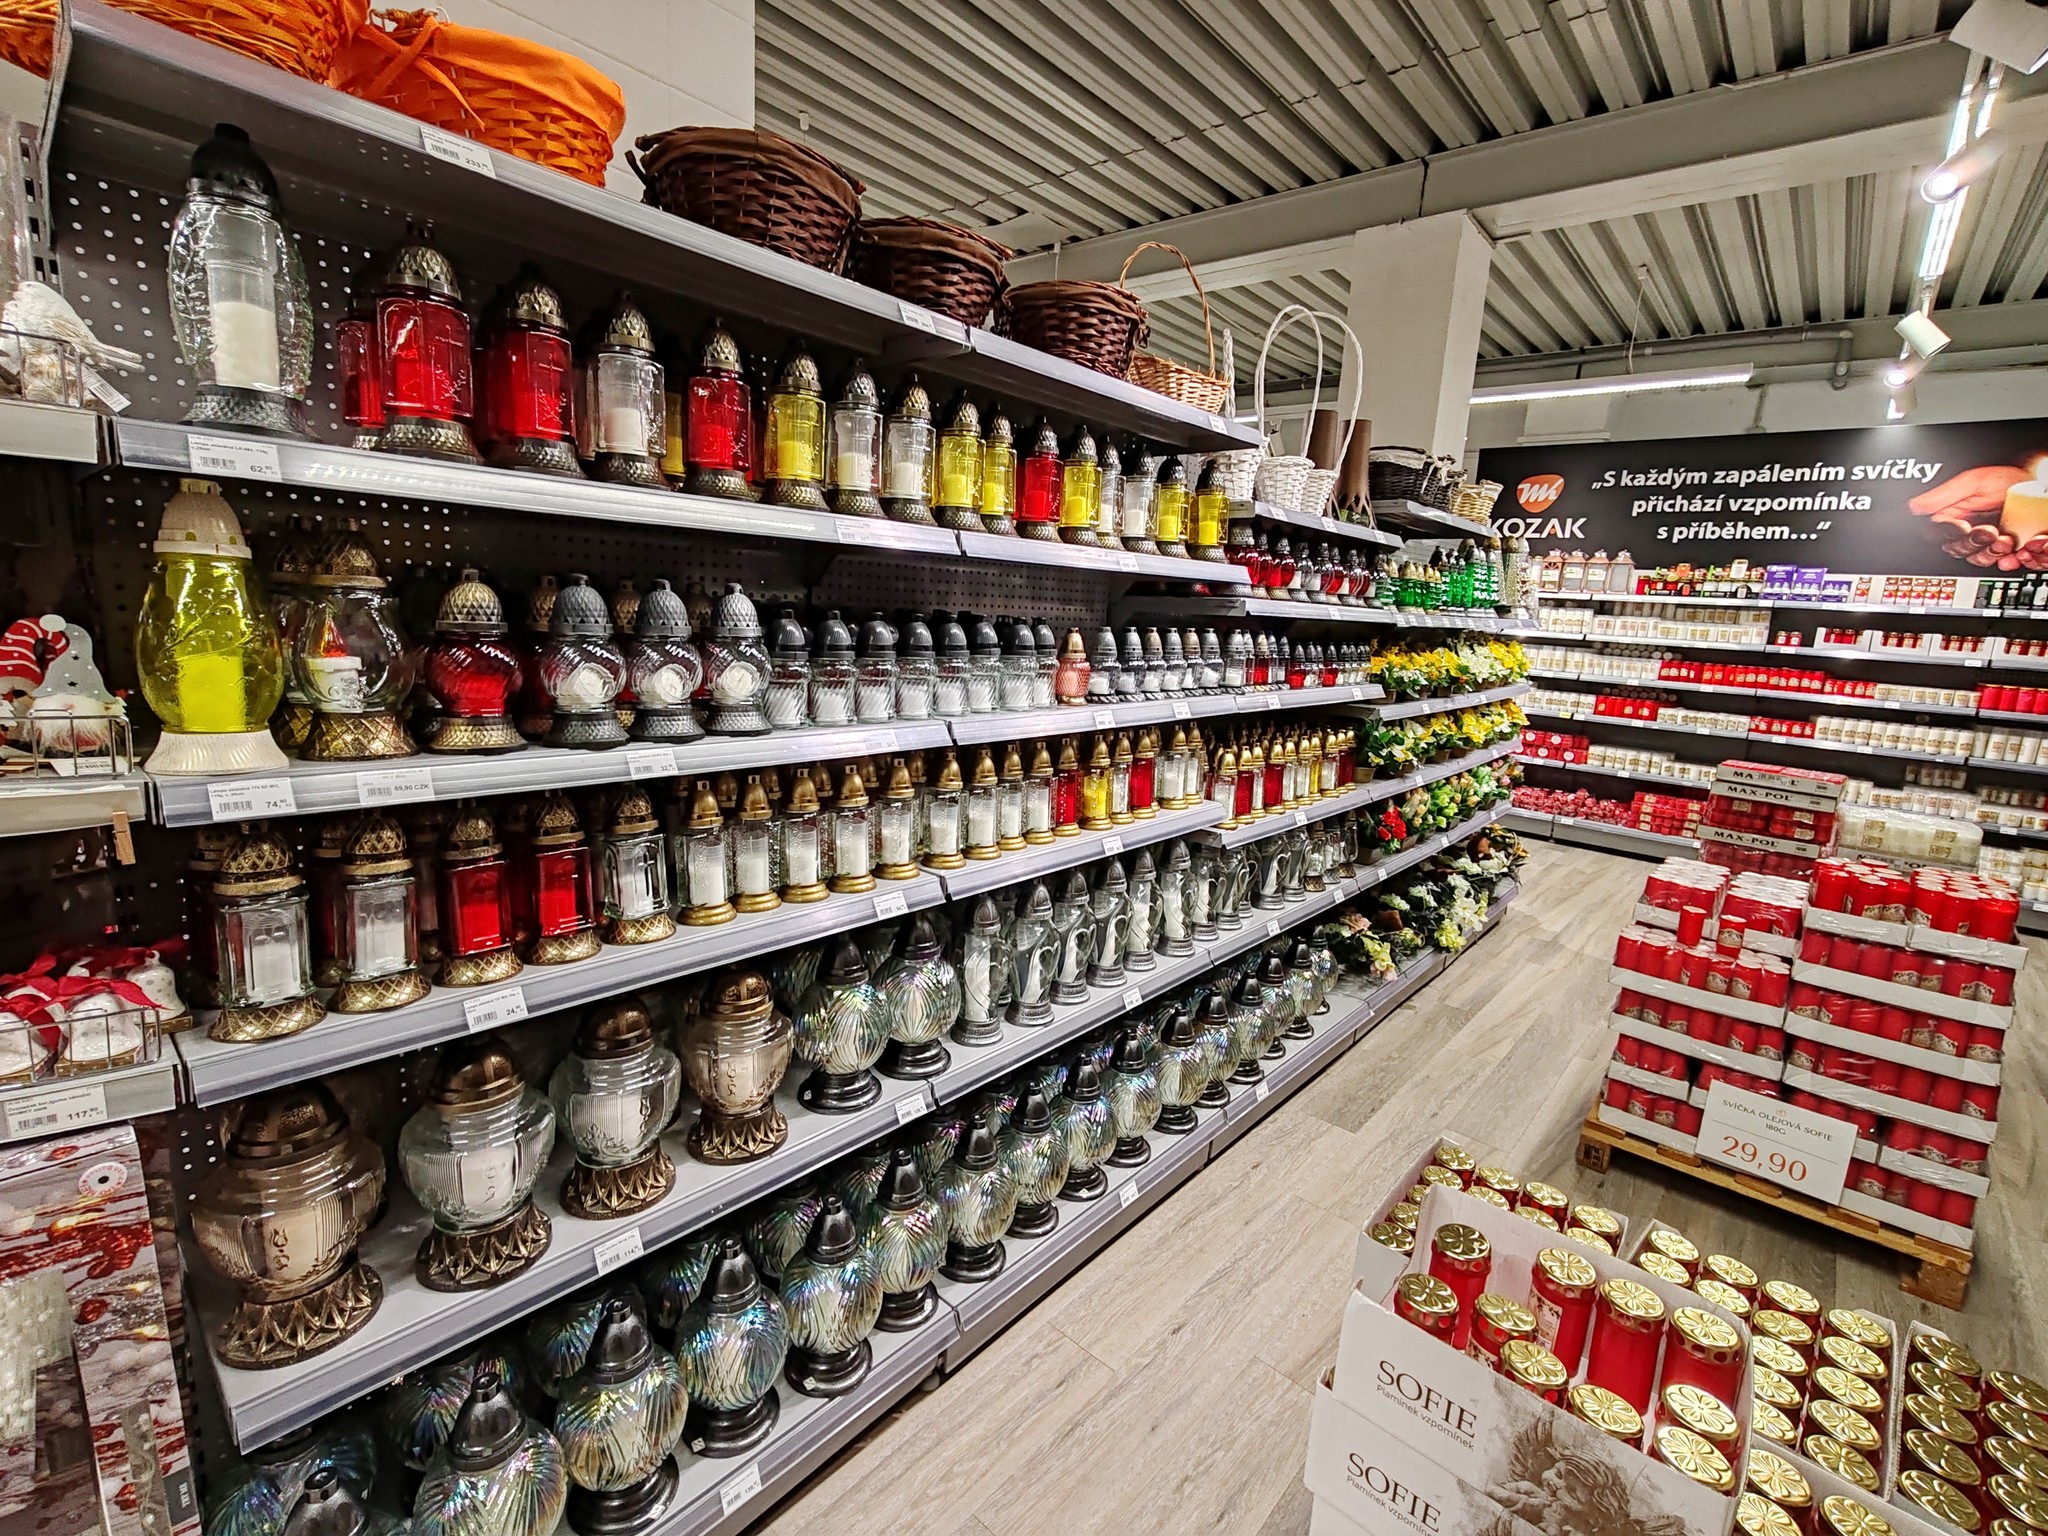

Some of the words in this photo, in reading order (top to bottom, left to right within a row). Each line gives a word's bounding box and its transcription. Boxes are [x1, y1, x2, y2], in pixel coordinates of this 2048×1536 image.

[1620, 468, 1708, 489] každým
[1712, 462, 1845, 488] zapálením
[1851, 458, 1942, 484] svíčky
[1631, 494, 1726, 517] přichází
[1728, 491, 1872, 516] vzpomínka
[1488, 518, 1587, 539] KOZAK
[1656, 525, 1668, 540] s
[1727, 785, 1793, 801] MAX-POL
[1714, 831, 1779, 848] MAX-POL
[1722, 1099, 1756, 1116] SVÍČKA
[1758, 1110, 1801, 1131] OLEJOVÁ
[1804, 1126, 1834, 1142] SOFIE
[1765, 1123, 1786, 1136] 180G
[1721, 1135, 1808, 1182] 29,90
[1377, 1360, 1478, 1439] SOFIE
[1376, 1384, 1420, 1417] Plamínek
[1420, 1413, 1475, 1452] vzpomínek
[1346, 1475, 1387, 1509] Plamínek
[1347, 1452, 1441, 1533] SOFIE
